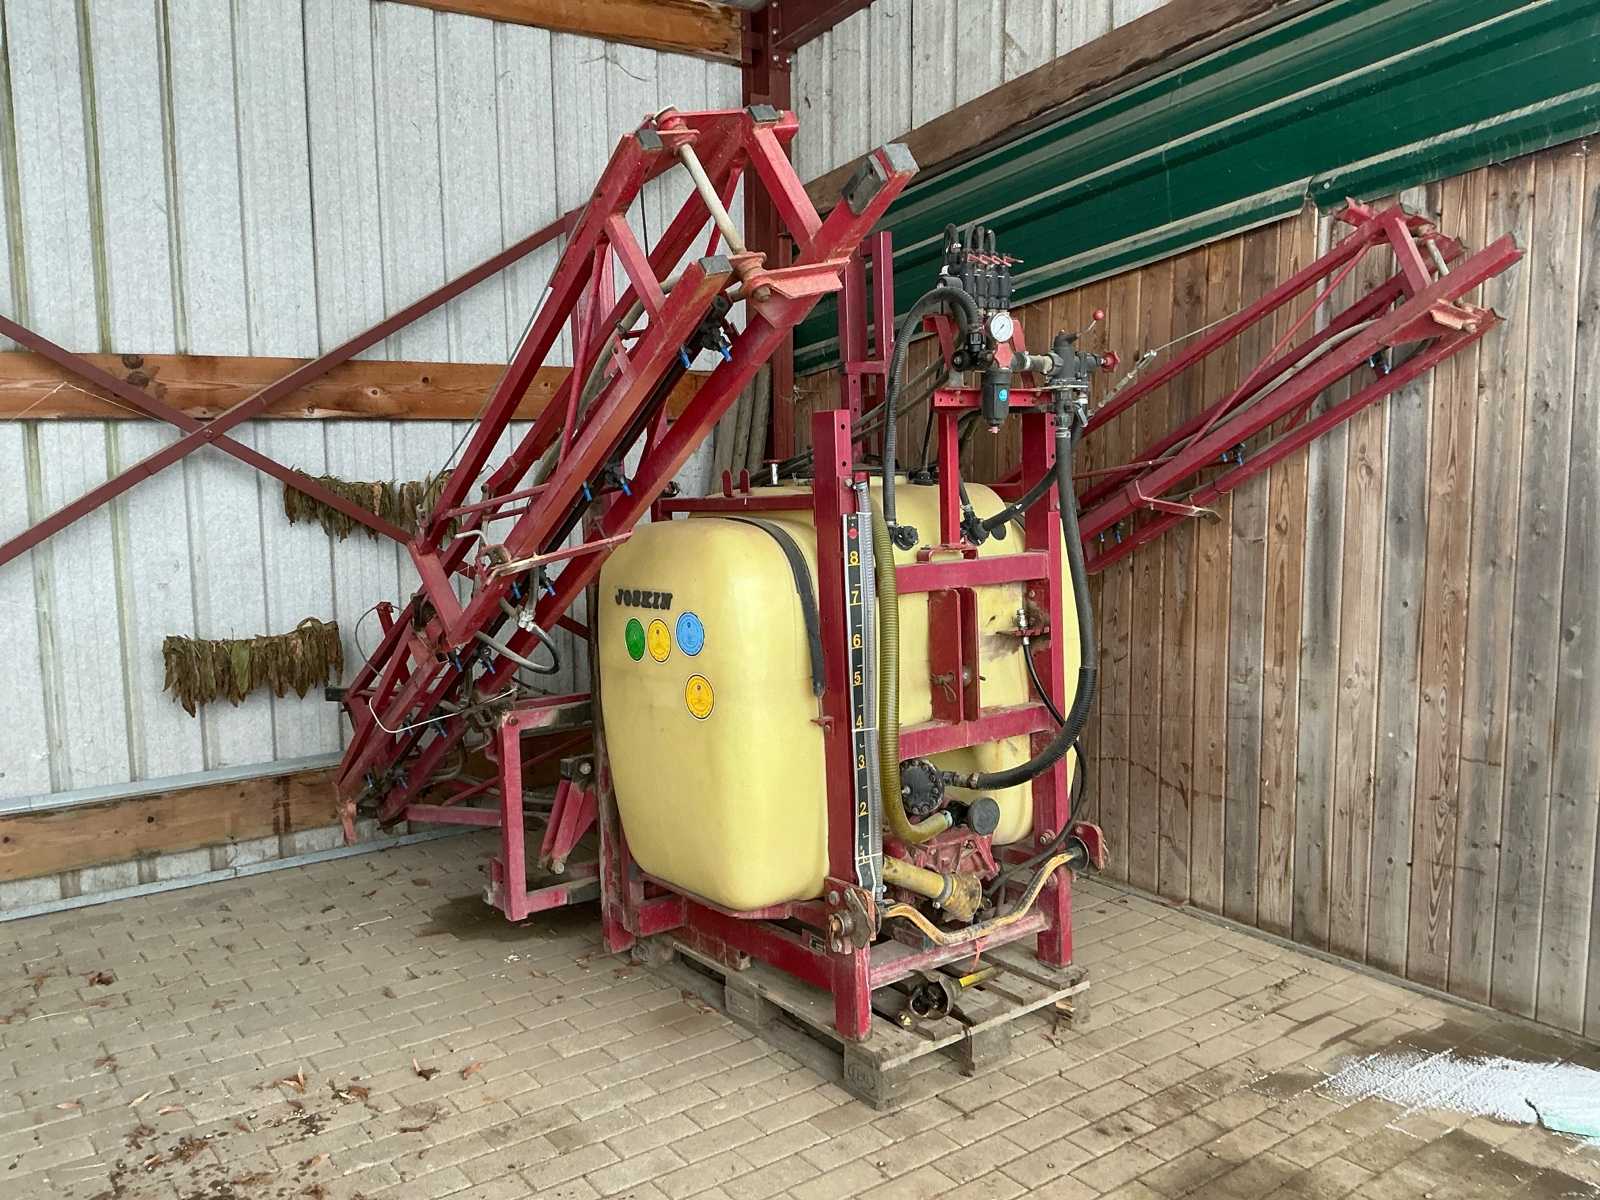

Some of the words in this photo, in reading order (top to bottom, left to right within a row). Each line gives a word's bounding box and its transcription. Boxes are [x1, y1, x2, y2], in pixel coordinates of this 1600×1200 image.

[850, 551, 859, 565] 8
[615, 589, 673, 610] JOSKIN
[851, 591, 859, 604] 7
[853, 634, 862, 647] 6
[854, 671, 861, 683] 5
[856, 715, 864, 728] 4
[858, 755, 866, 767] 3
[860, 802, 867, 815] 2
